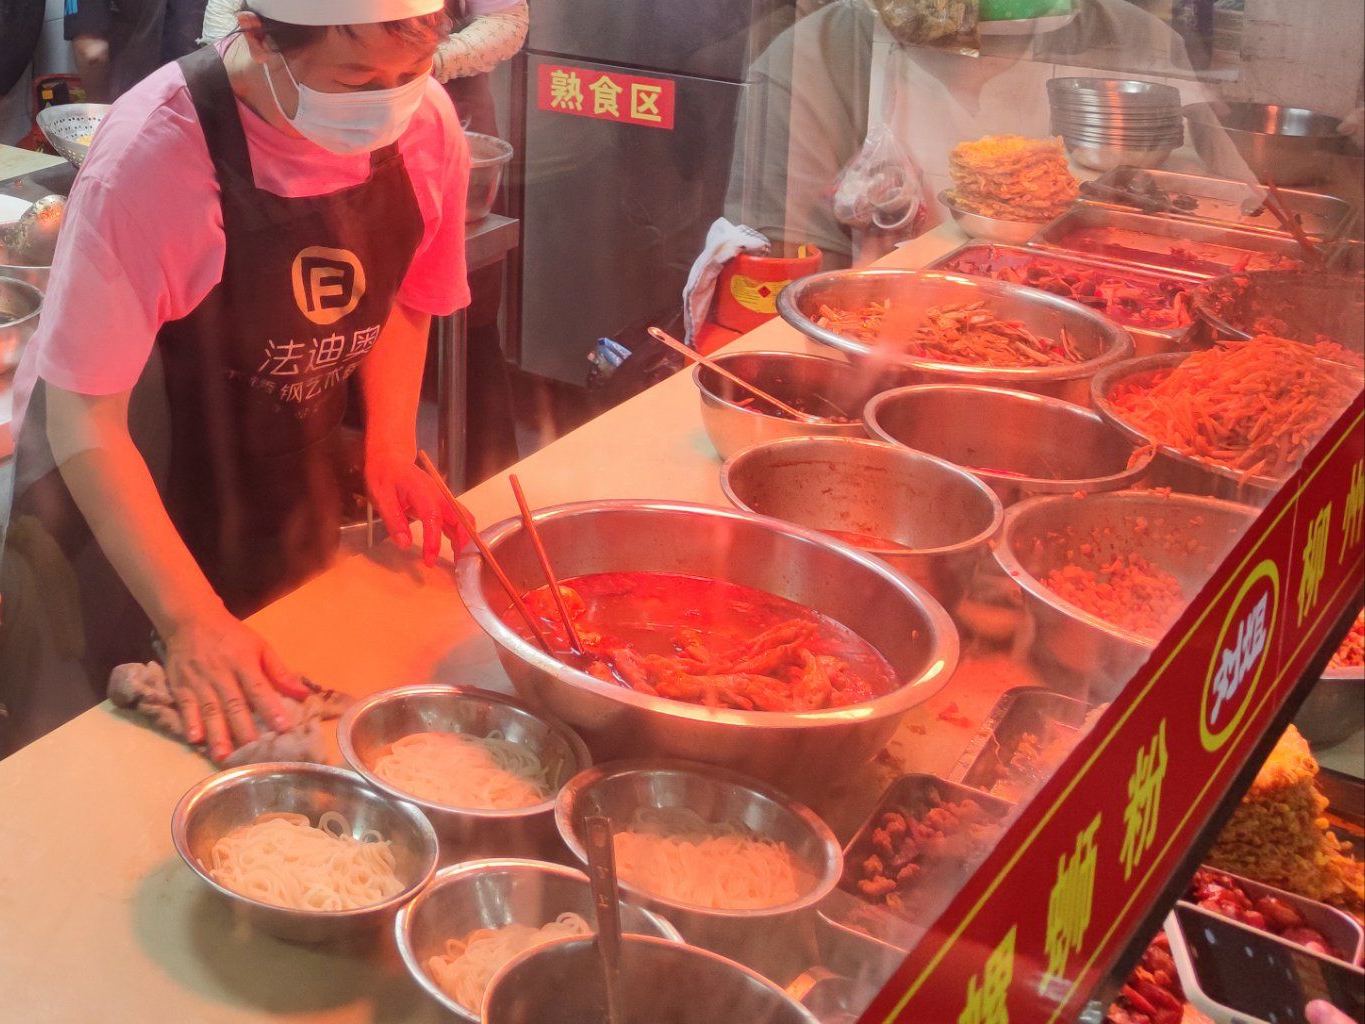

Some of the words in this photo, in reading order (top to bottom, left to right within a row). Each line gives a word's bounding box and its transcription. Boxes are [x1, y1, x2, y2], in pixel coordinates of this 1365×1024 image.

[550, 69, 662, 123] 熟食区
[258, 324, 381, 377] 法迪奥
